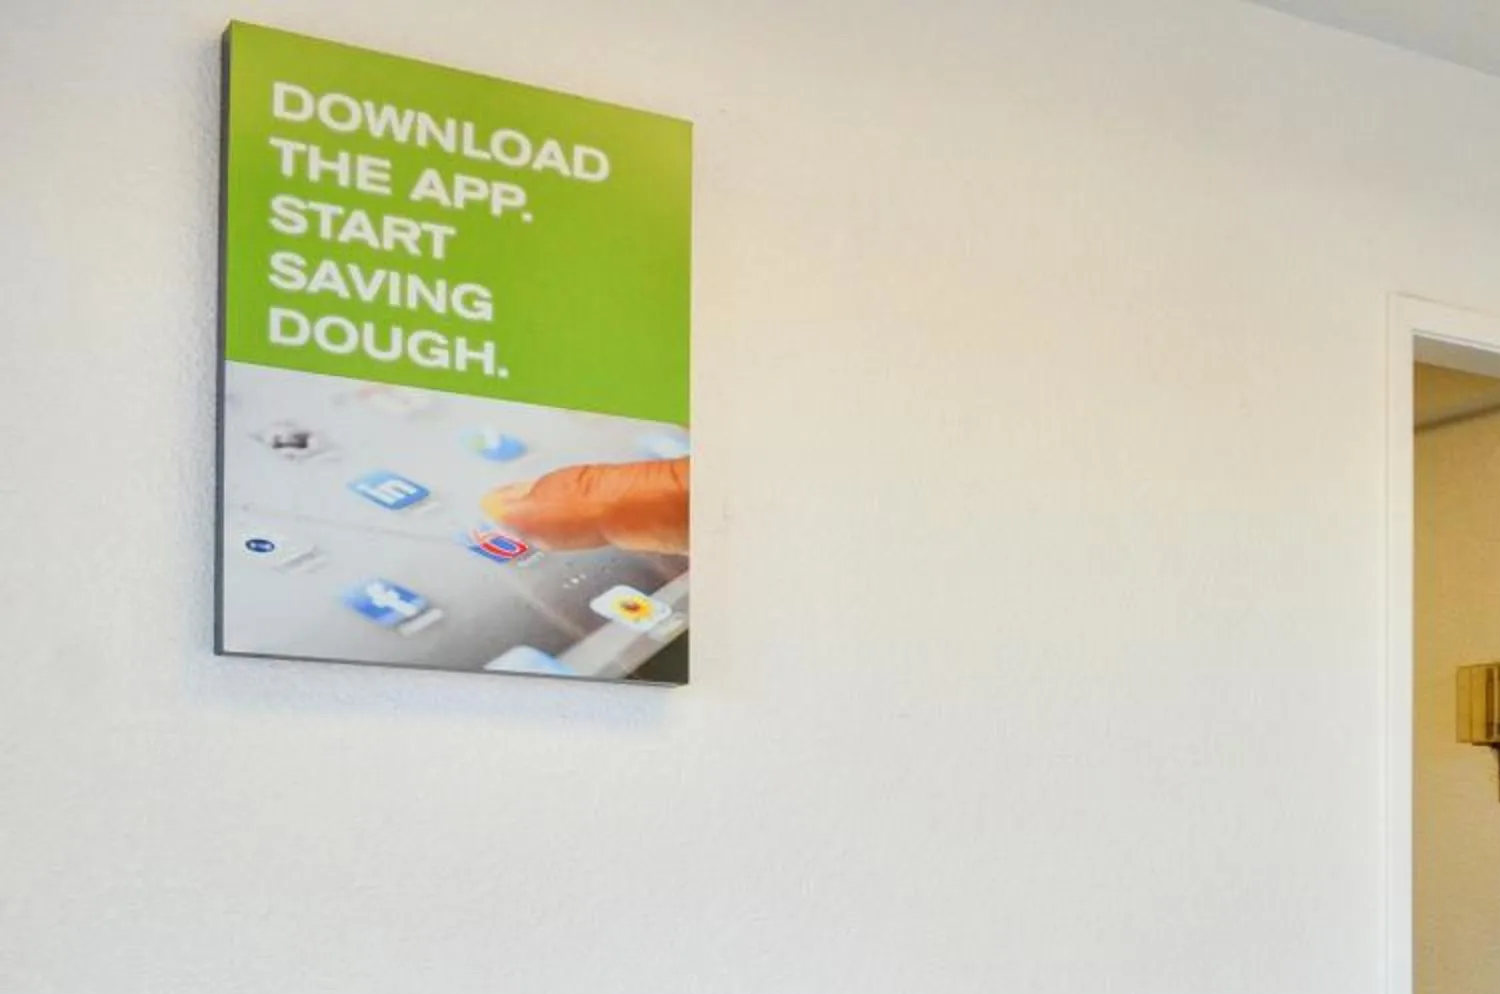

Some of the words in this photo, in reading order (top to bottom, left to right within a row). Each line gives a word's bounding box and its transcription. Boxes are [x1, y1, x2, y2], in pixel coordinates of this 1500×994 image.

[272, 82, 610, 182] DOWNLOAD
[269, 138, 391, 195] THE
[410, 167, 533, 222] APP.
[269, 197, 456, 259] START
[269, 252, 494, 321] SAVING
[269, 308, 510, 378] DOUGH.
